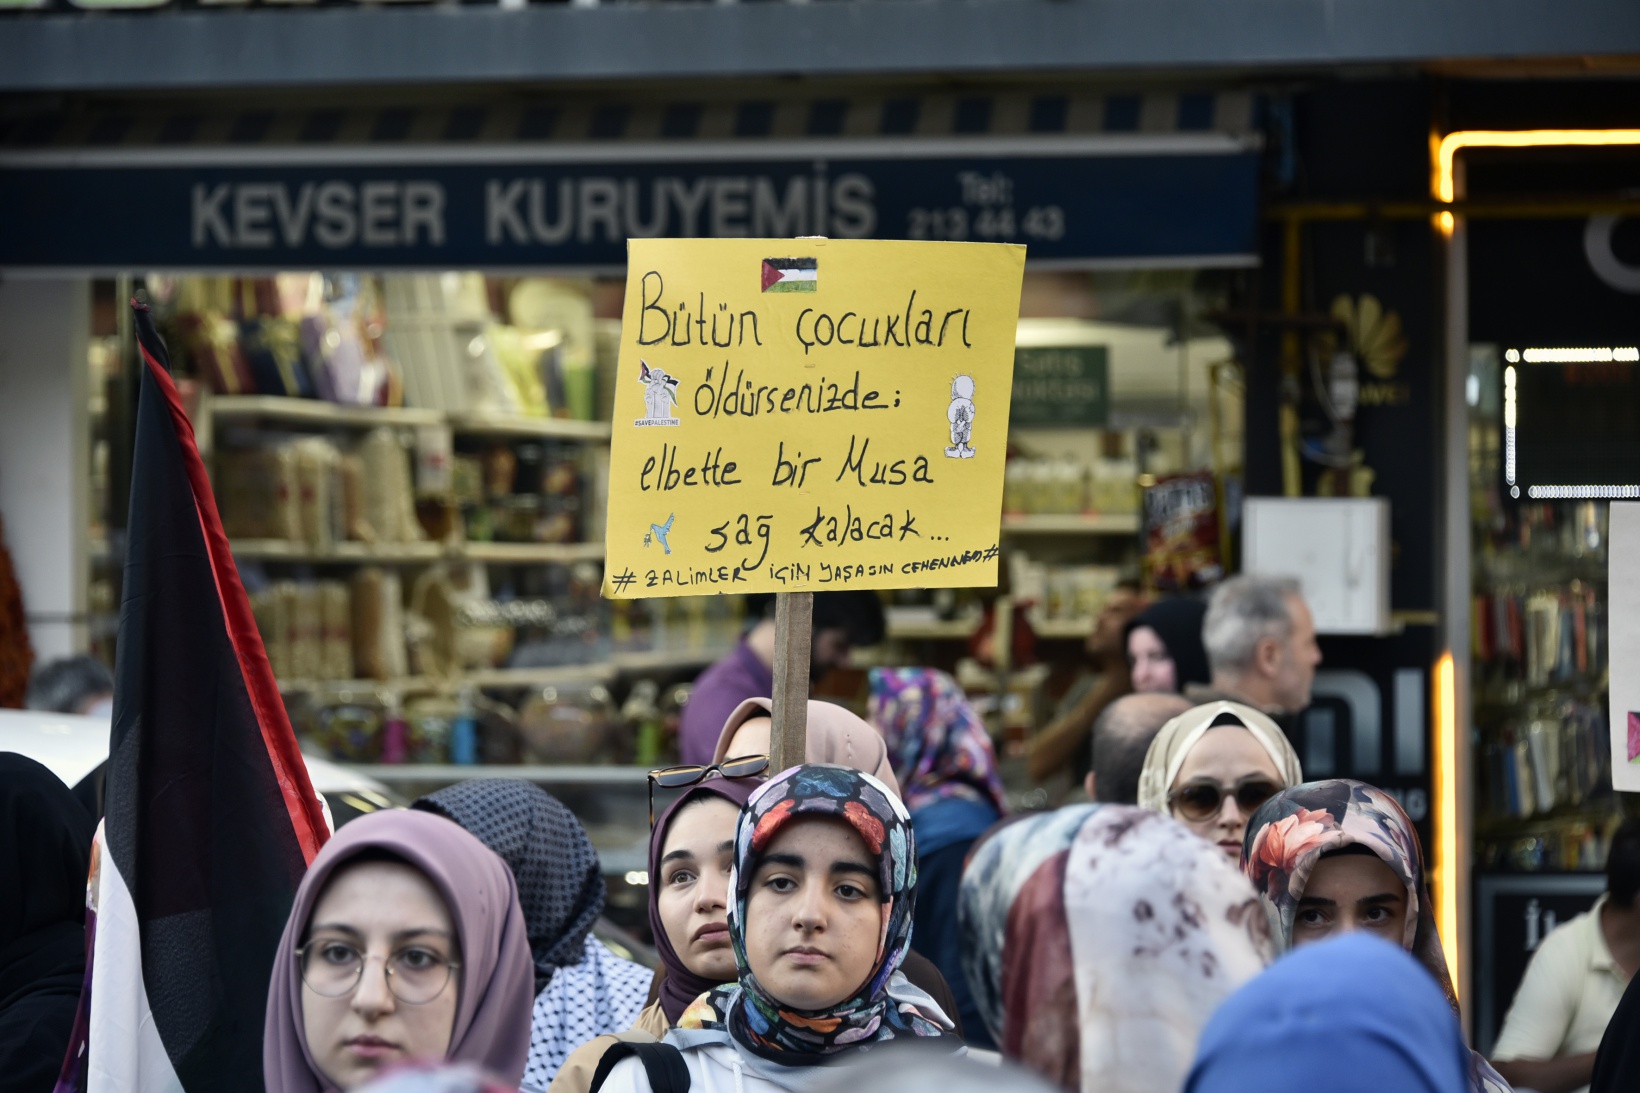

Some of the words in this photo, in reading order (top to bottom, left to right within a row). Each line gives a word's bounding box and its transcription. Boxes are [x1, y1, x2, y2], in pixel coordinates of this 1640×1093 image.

[191, 178, 446, 248] KEVSER
[907, 206, 968, 240] 213
[973, 206, 1016, 240] 44
[1021, 205, 1064, 241] 43
[636, 271, 763, 348] Bütün
[796, 289, 973, 355] çocukları
[640, 442, 742, 491] elbette
[772, 441, 821, 489] bir
[836, 435, 934, 487] Musa
[704, 513, 773, 571] sağ
